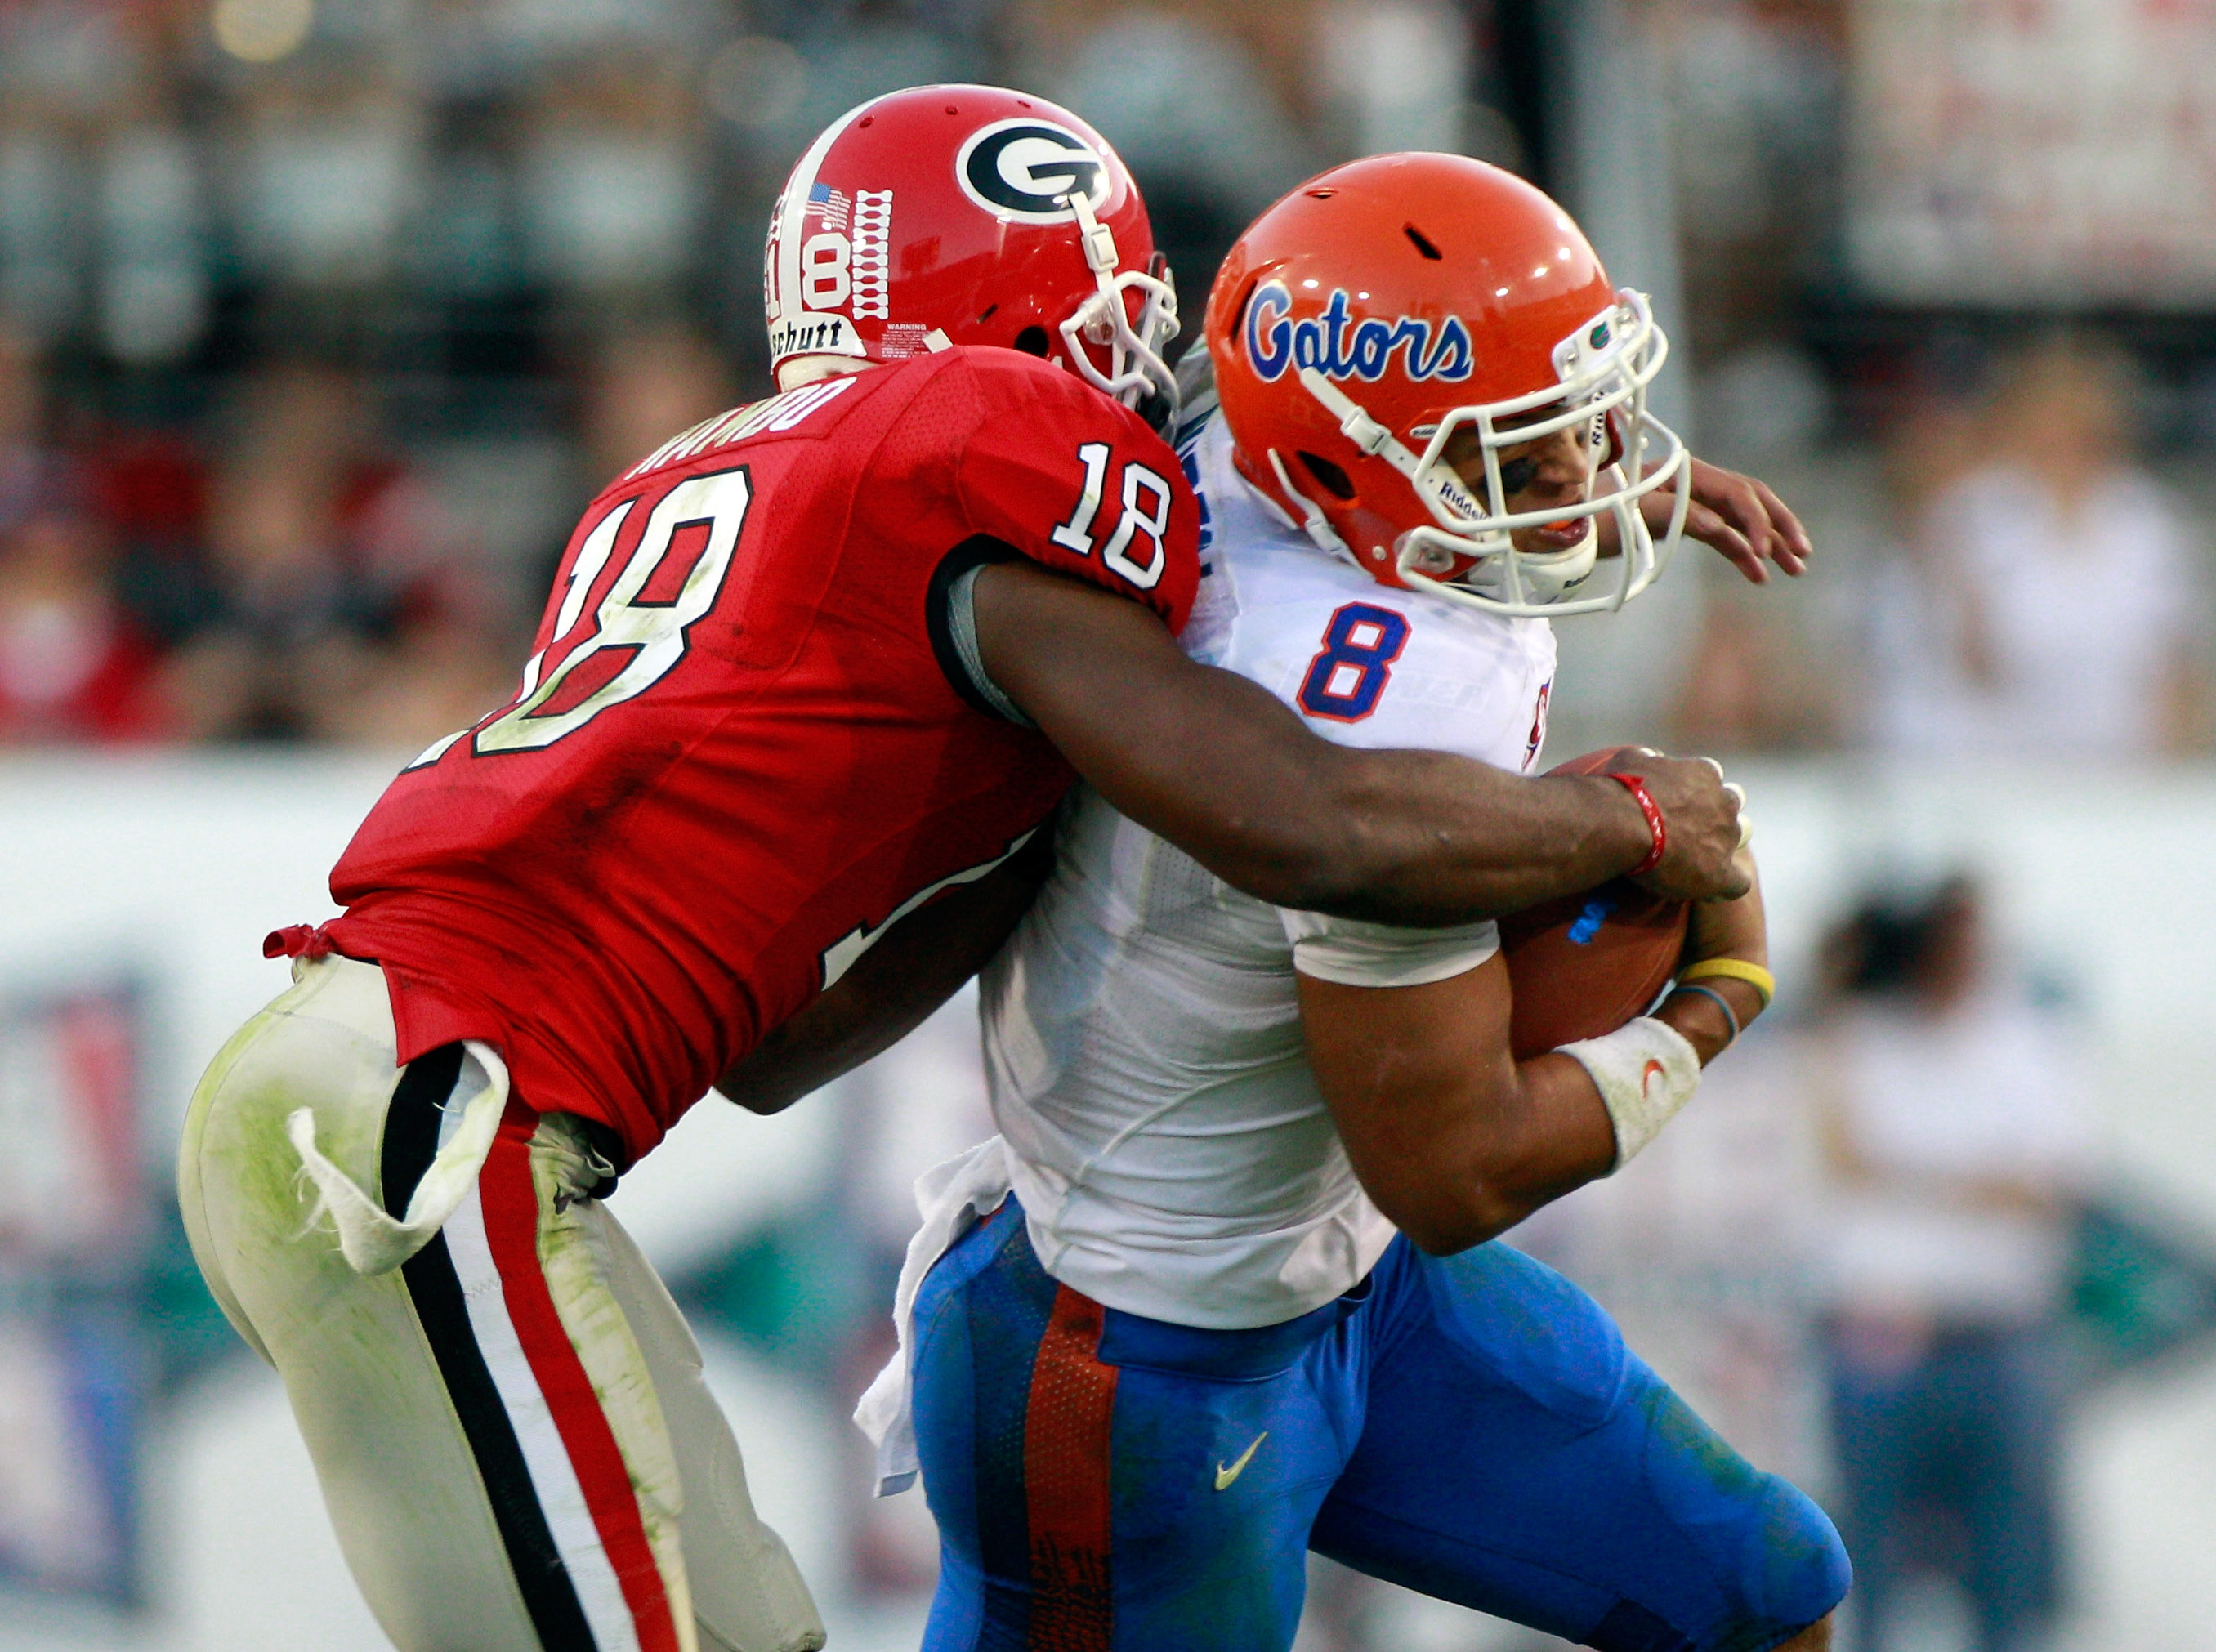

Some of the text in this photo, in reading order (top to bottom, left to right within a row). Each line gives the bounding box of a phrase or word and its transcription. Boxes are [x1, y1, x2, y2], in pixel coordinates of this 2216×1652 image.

[967, 127, 1101, 212] G
[1245, 279, 1473, 382] Gators
[1050, 442, 1172, 589] 18
[399, 463, 753, 775] 18
[1296, 601, 1413, 724] 8
